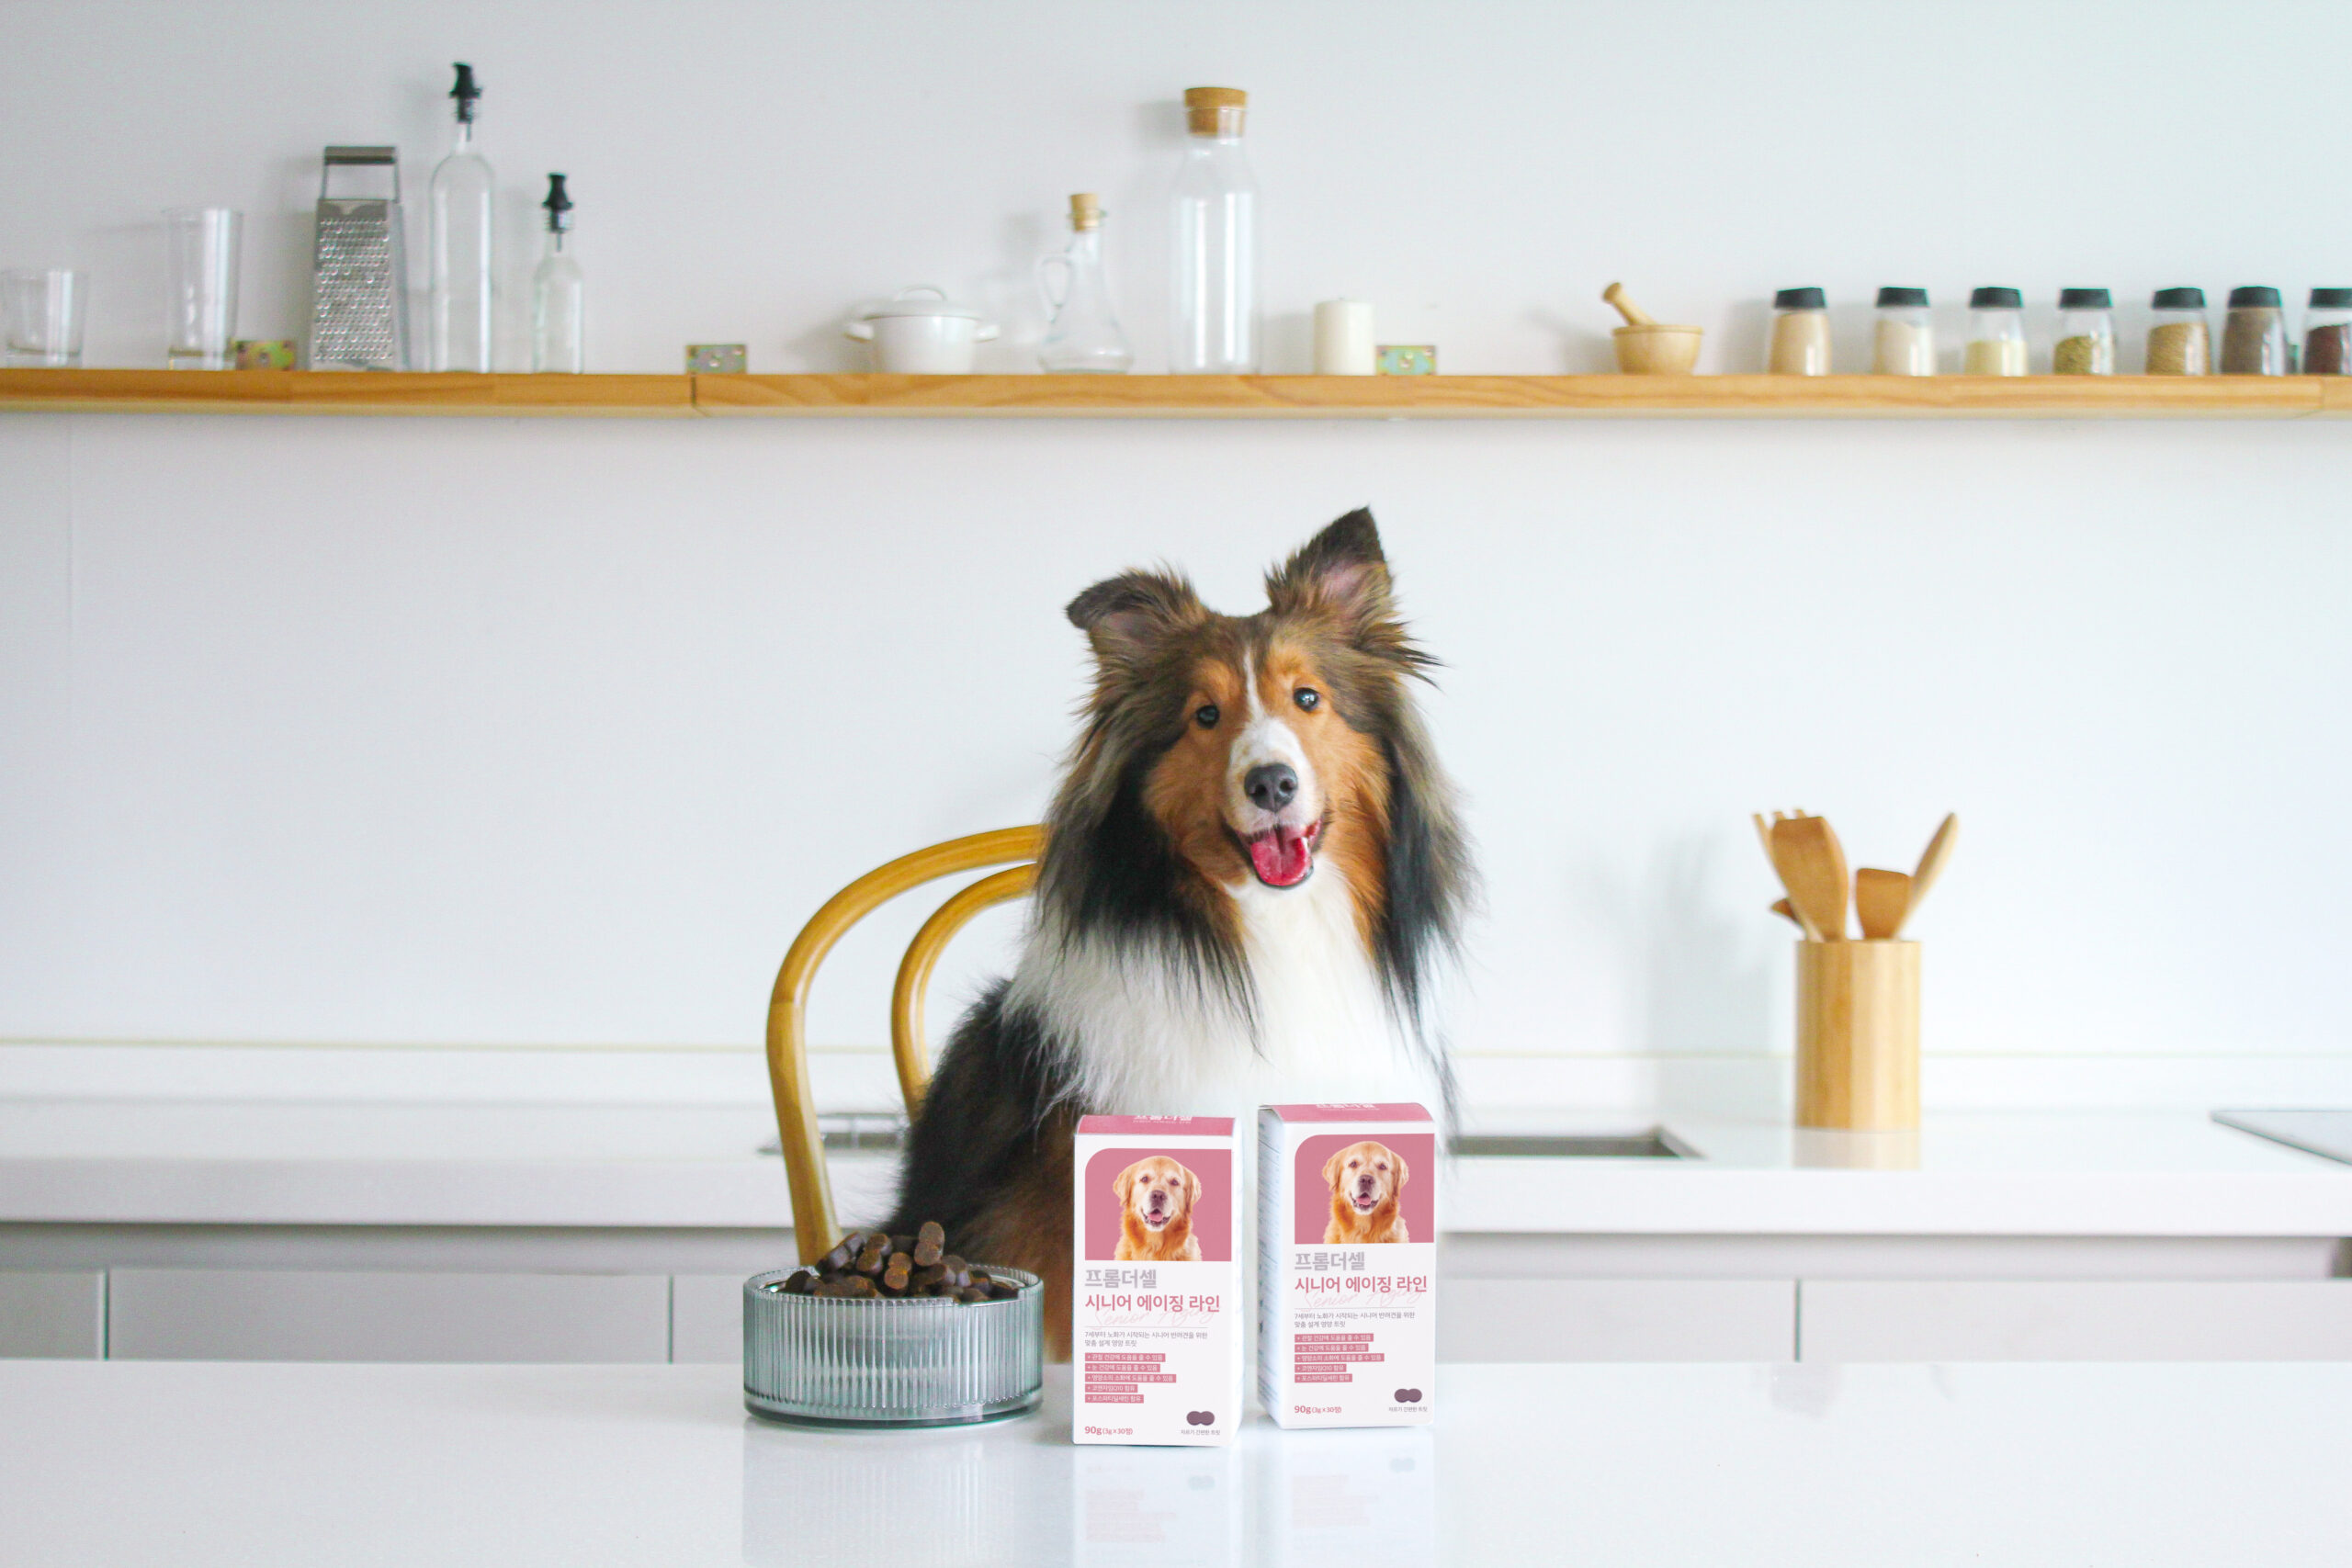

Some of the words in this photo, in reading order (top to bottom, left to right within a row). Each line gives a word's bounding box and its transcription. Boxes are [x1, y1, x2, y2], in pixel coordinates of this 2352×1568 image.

[1295, 1251, 1365, 1271] 프롬더셀
[1085, 1269, 1157, 1289] 프롬더셀
[1295, 1276, 1340, 1293] 시니어
[1345, 1276, 1391, 1293] 에이징
[1396, 1275, 1427, 1292] 라인
[1085, 1294, 1132, 1312] 시니어
[1136, 1294, 1183, 1312] 에이징
[1189, 1294, 1220, 1312] 라인
[1295, 1405, 1311, 1415] 90g
[1085, 1426, 1102, 1436] 90g
